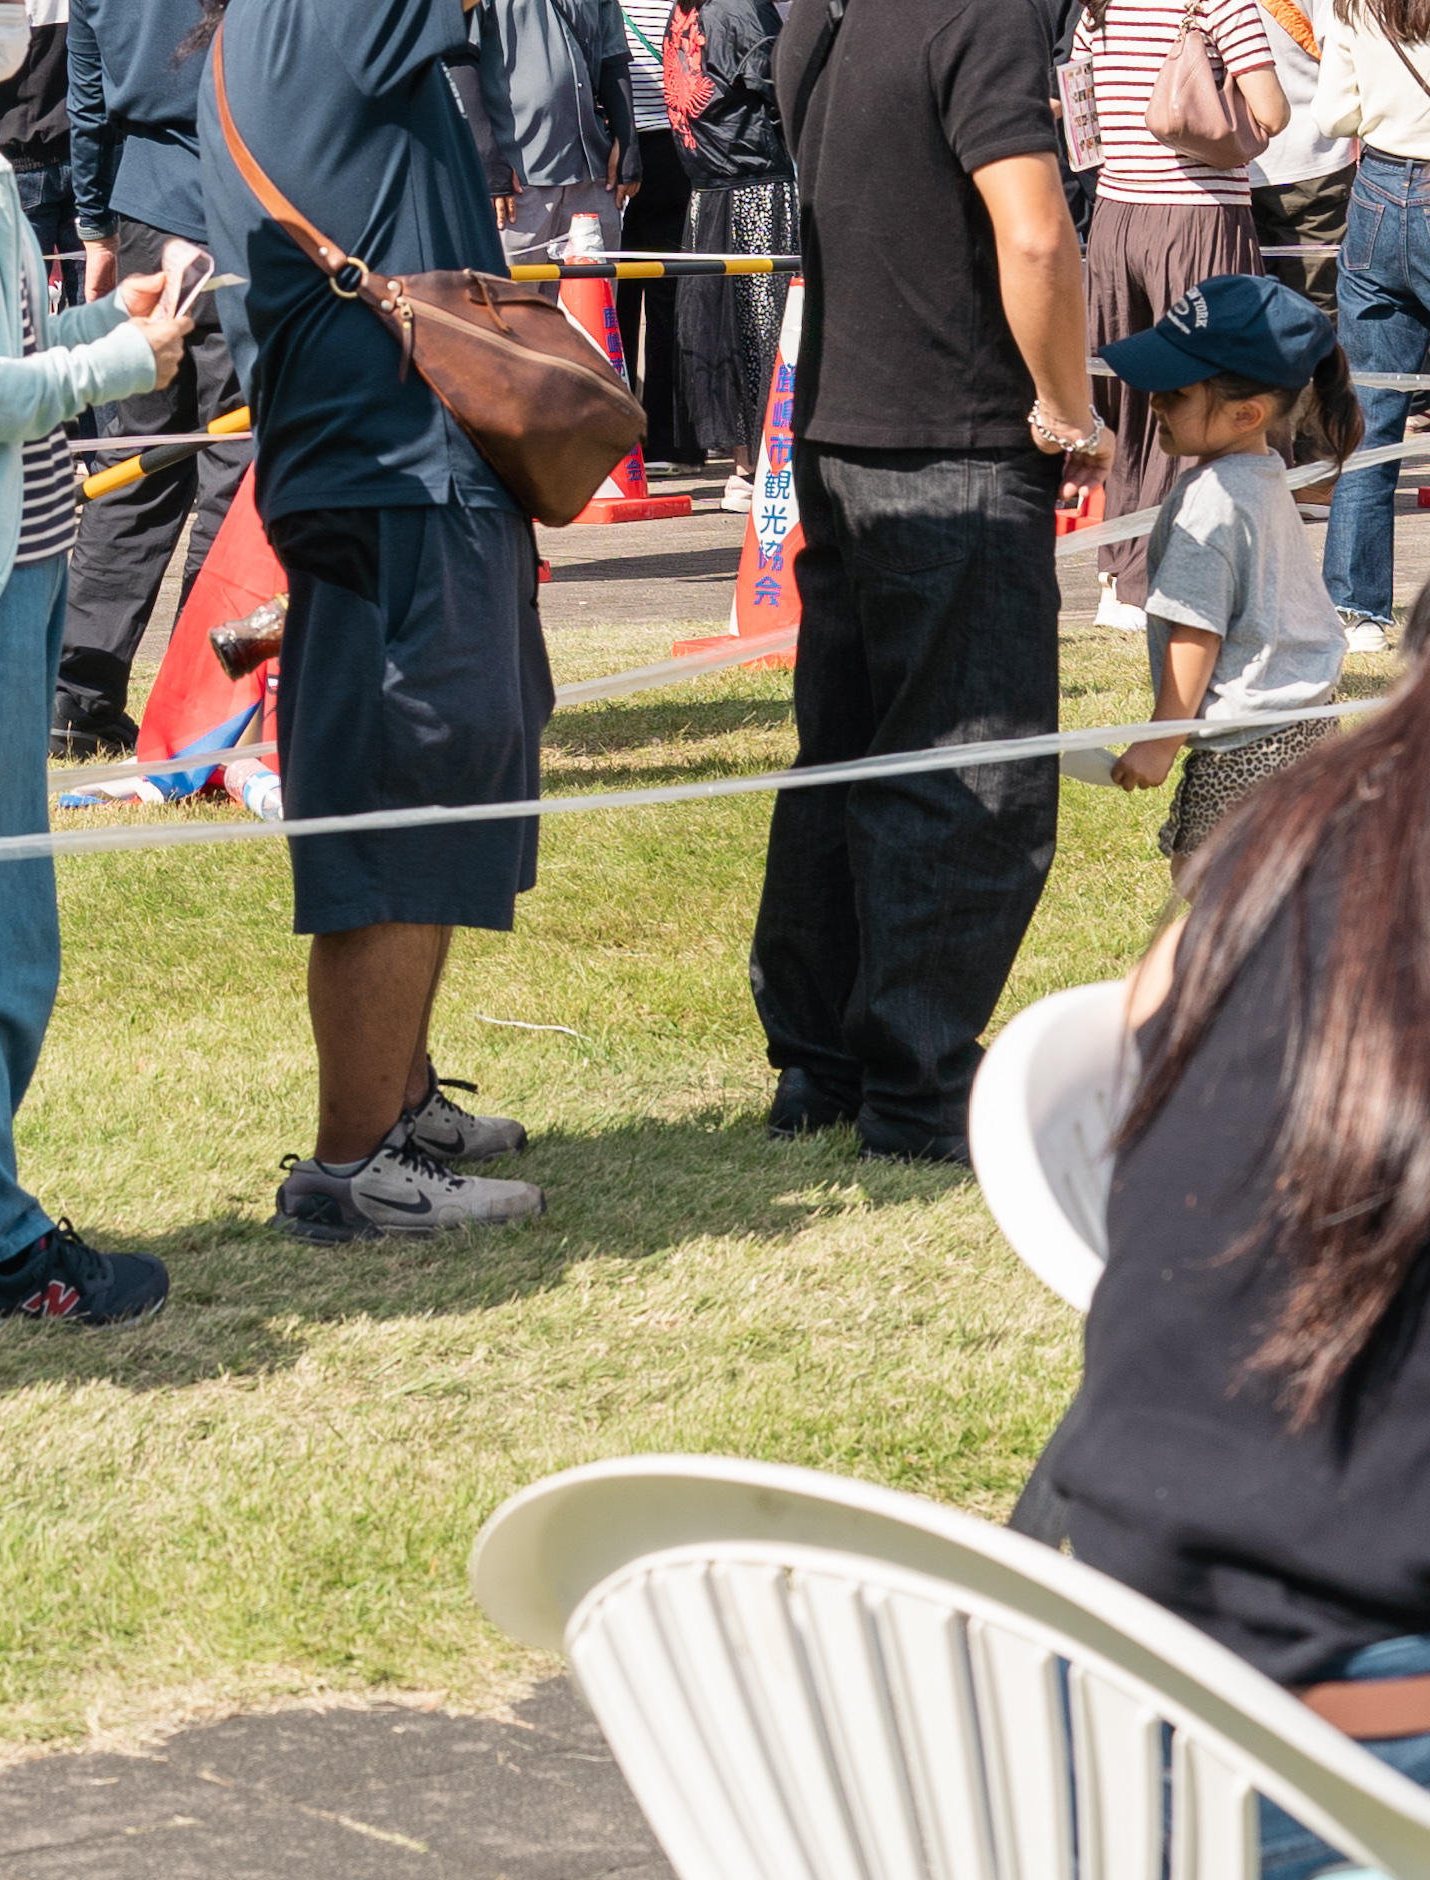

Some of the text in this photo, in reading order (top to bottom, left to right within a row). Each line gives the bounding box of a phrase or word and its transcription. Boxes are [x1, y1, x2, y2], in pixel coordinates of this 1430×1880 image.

[754, 363, 795, 607] 鹿嶋市観光協会
